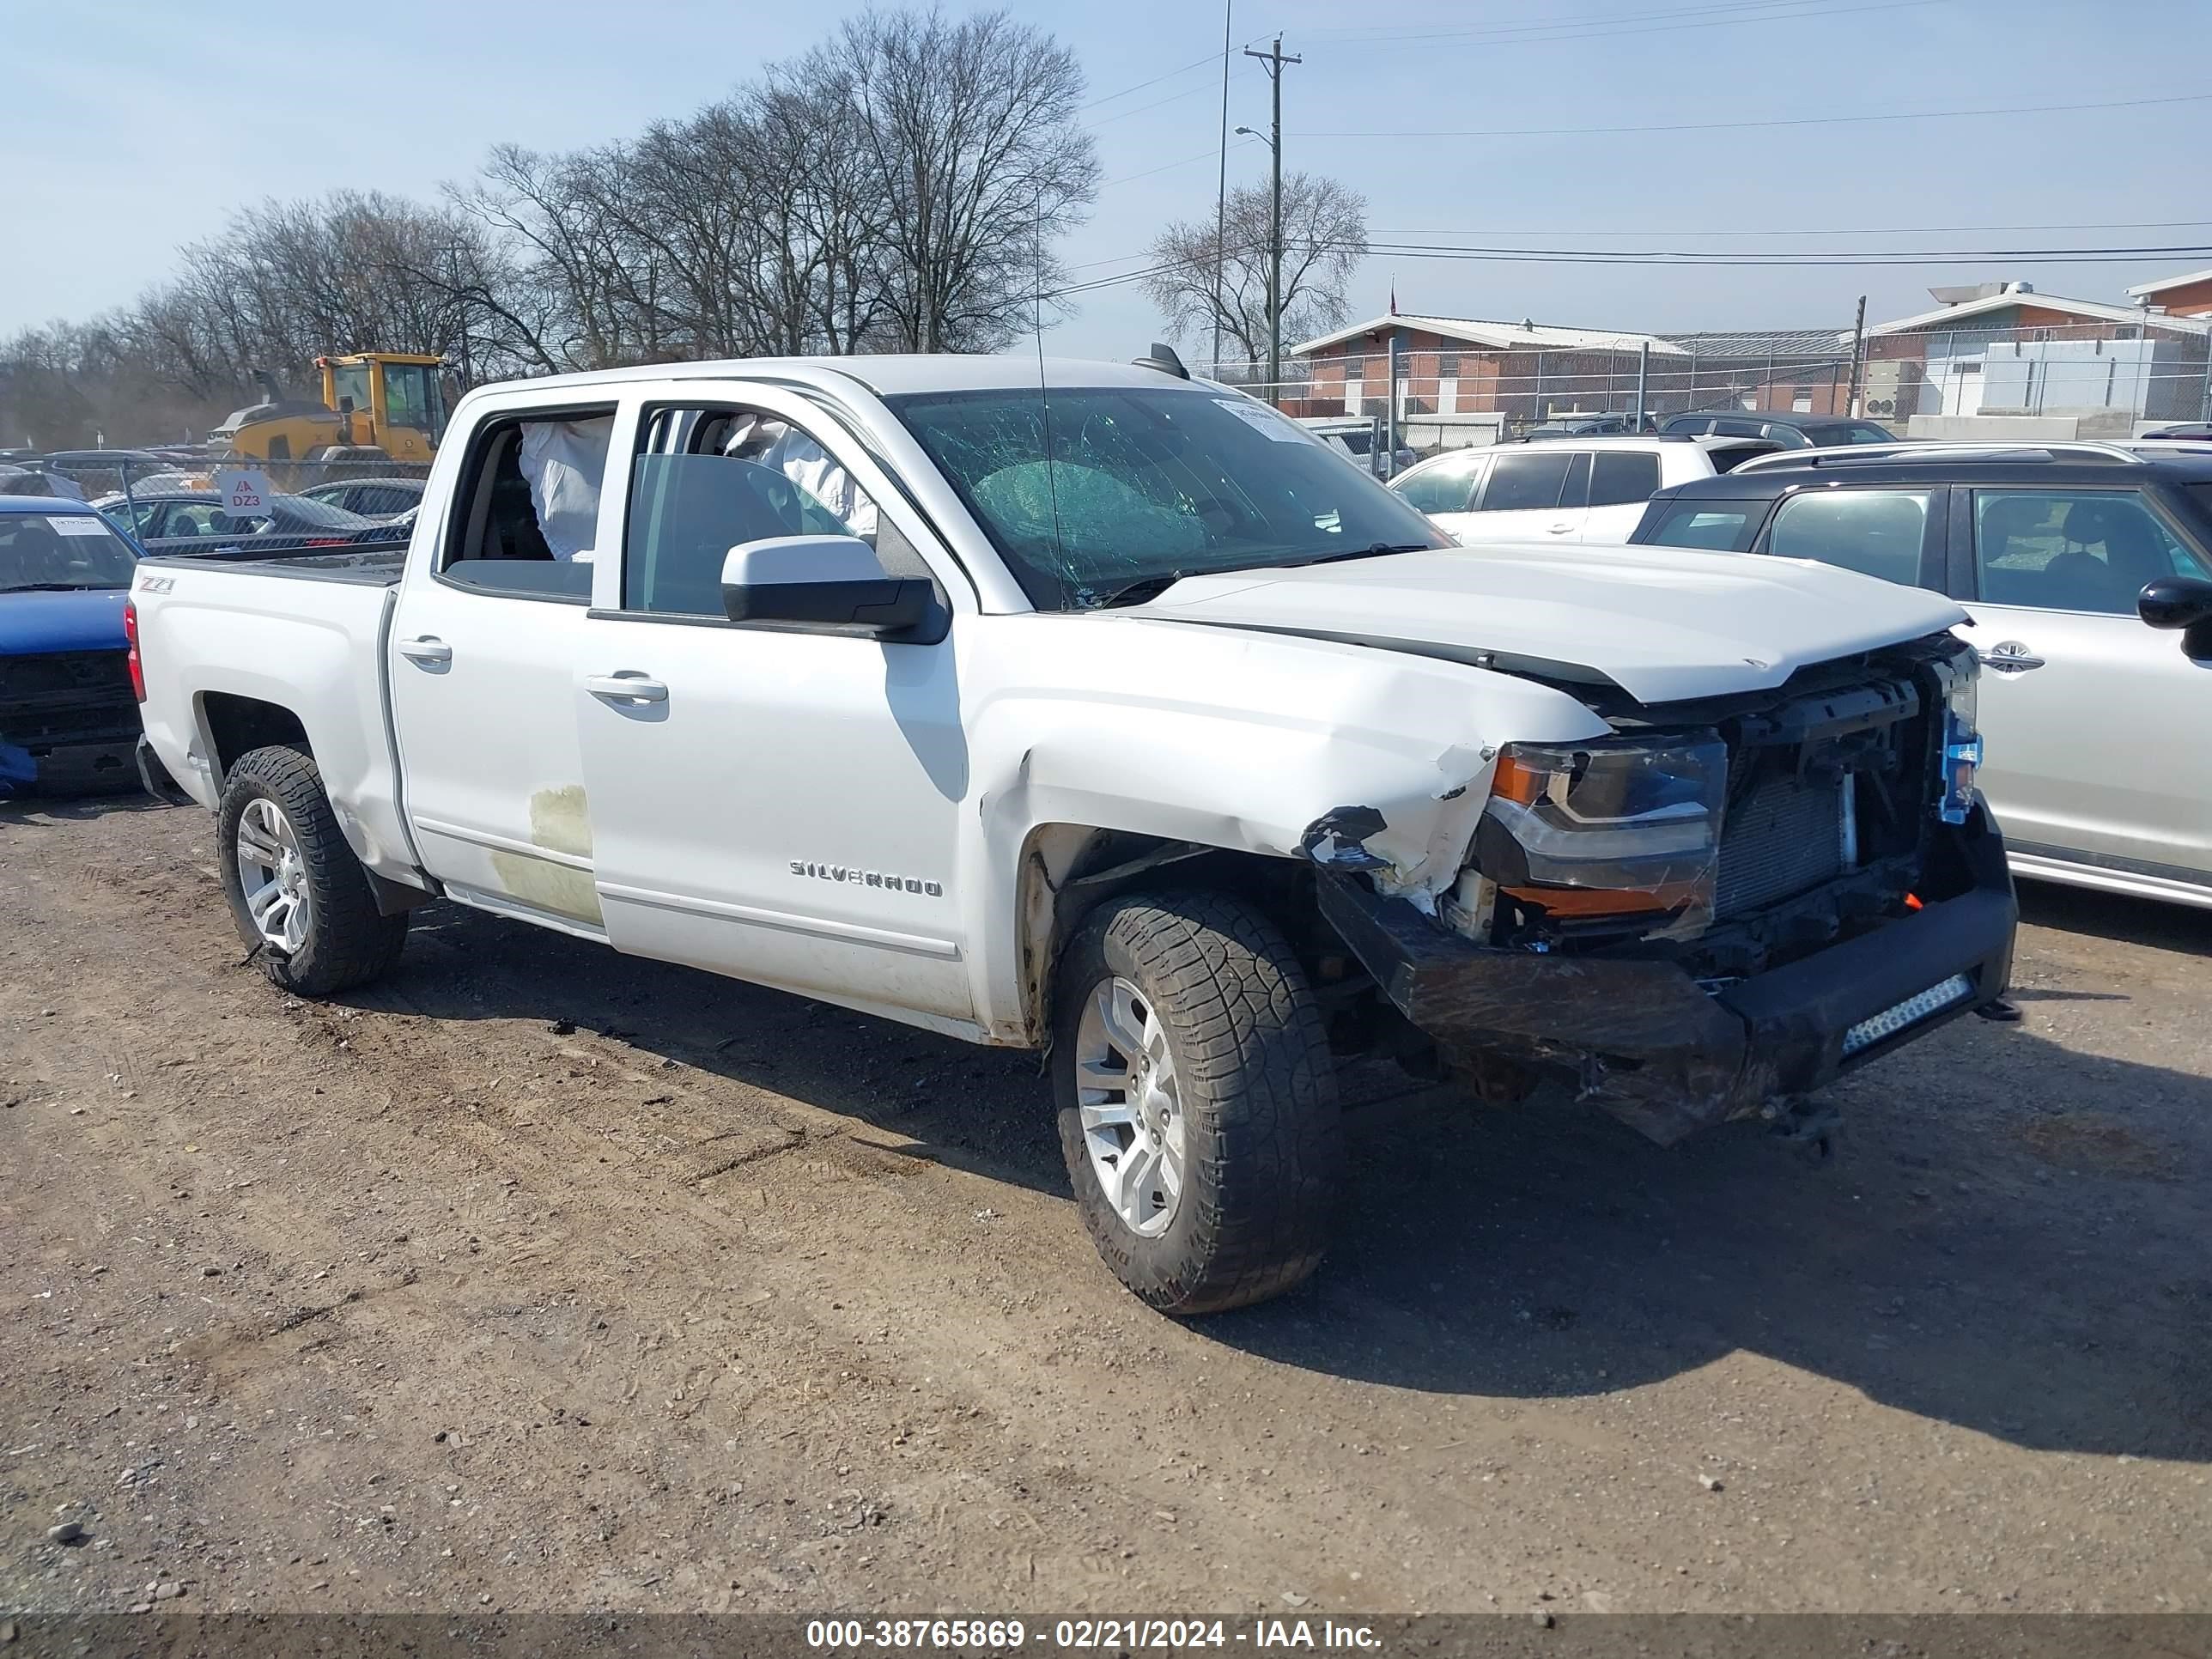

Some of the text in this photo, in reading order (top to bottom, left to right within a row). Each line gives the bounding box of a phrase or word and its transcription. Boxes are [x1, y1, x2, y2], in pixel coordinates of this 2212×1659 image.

[233, 495, 260, 507] DZ3
[139, 576, 177, 595] Z71
[790, 860, 943, 897] SILVERADO
